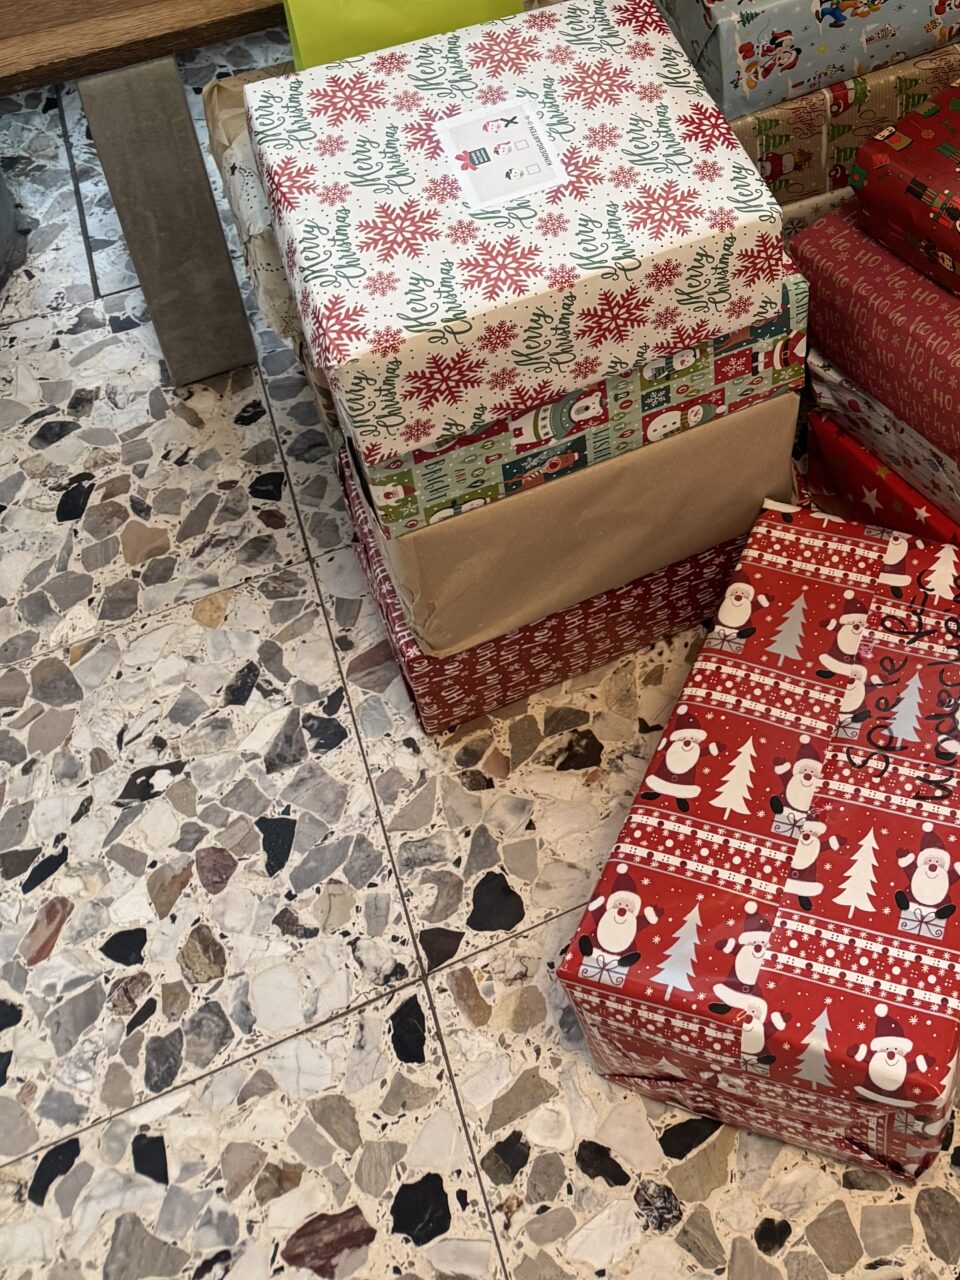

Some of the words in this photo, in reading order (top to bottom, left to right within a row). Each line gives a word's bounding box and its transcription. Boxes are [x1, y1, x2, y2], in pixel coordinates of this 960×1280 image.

[560, 3, 607, 53] Merry
[408, 44, 456, 98] Merry
[442, 33, 478, 98] Christmas
[656, 45, 703, 97] Merry
[254, 91, 293, 150] Merry
[281, 79, 317, 150] Christmas
[539, 76, 575, 141] Christmas
[653, 102, 693, 174] Christmas
[344, 135, 393, 194] Merry
[380, 124, 415, 194] Christmas
[528, 125, 552, 166] KINDERGARTEN
[622, 113, 672, 174] Merry
[727, 161, 776, 224] Merry
[300, 219, 341, 288] Merry
[328, 206, 367, 288] Christmas
[569, 213, 619, 280] Merry
[603, 200, 642, 281] Christmas
[708, 233, 737, 312] Christmas
[397, 272, 448, 345] Merry
[434, 258, 473, 345] Christmas
[675, 247, 715, 313] Merry
[511, 306, 553, 373] Merry
[550, 291, 577, 373] Christmas
[345, 371, 380, 437] Merry
[374, 357, 406, 435] Christmas
[454, 468, 468, 485] AND
[591, 426, 611, 463] WISHE
[422, 458, 450, 503] BRIGHT
[847, 656, 908, 778] Spiele
[881, 568, 937, 646] für
